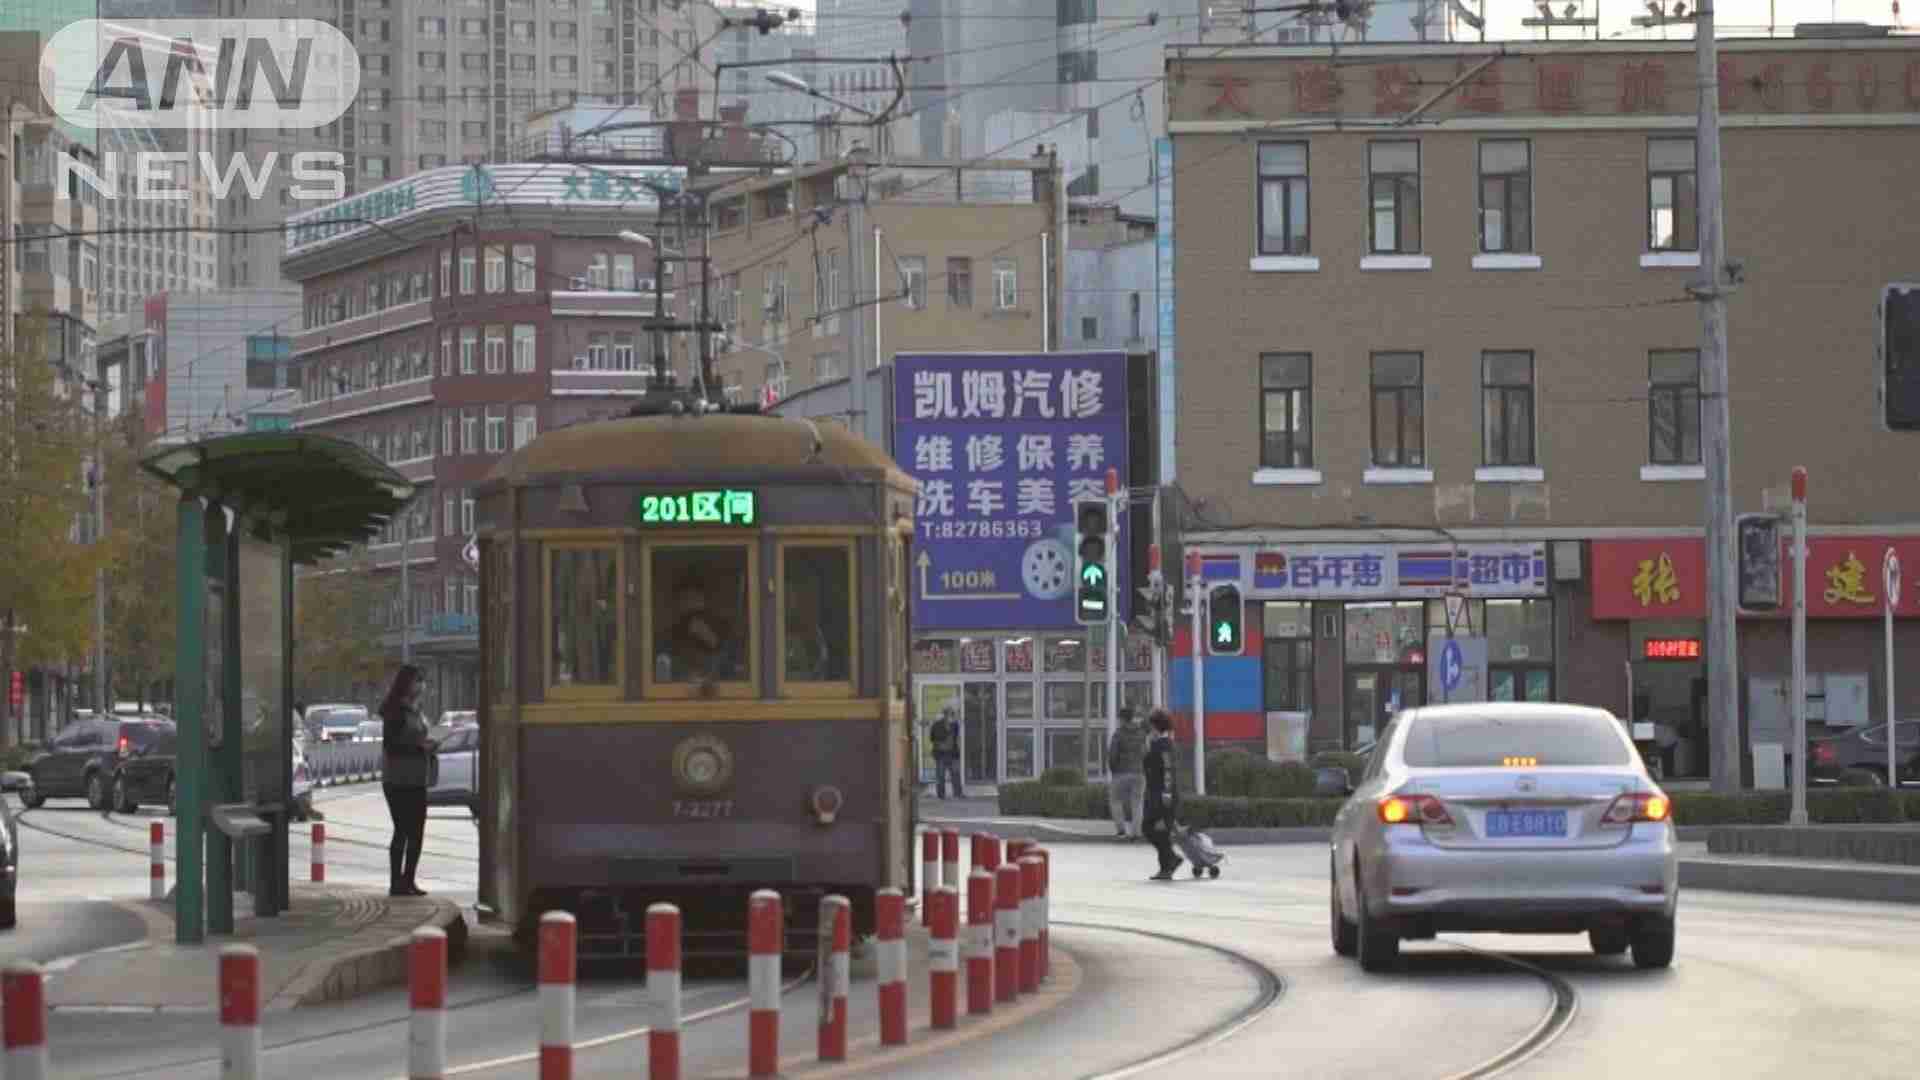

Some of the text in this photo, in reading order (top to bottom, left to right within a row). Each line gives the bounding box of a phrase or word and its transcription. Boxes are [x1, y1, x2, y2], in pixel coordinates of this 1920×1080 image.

[914, 369, 1104, 418] 凯姆汽修
[915, 434, 1105, 472] 维修保养
[642, 489, 754, 523] 201区间
[916, 477, 1106, 516] 洗车美容
[921, 521, 1042, 537] T:82786363
[941, 570, 995, 588] 100米
[1291, 554, 1531, 587] 百年惠 超市
